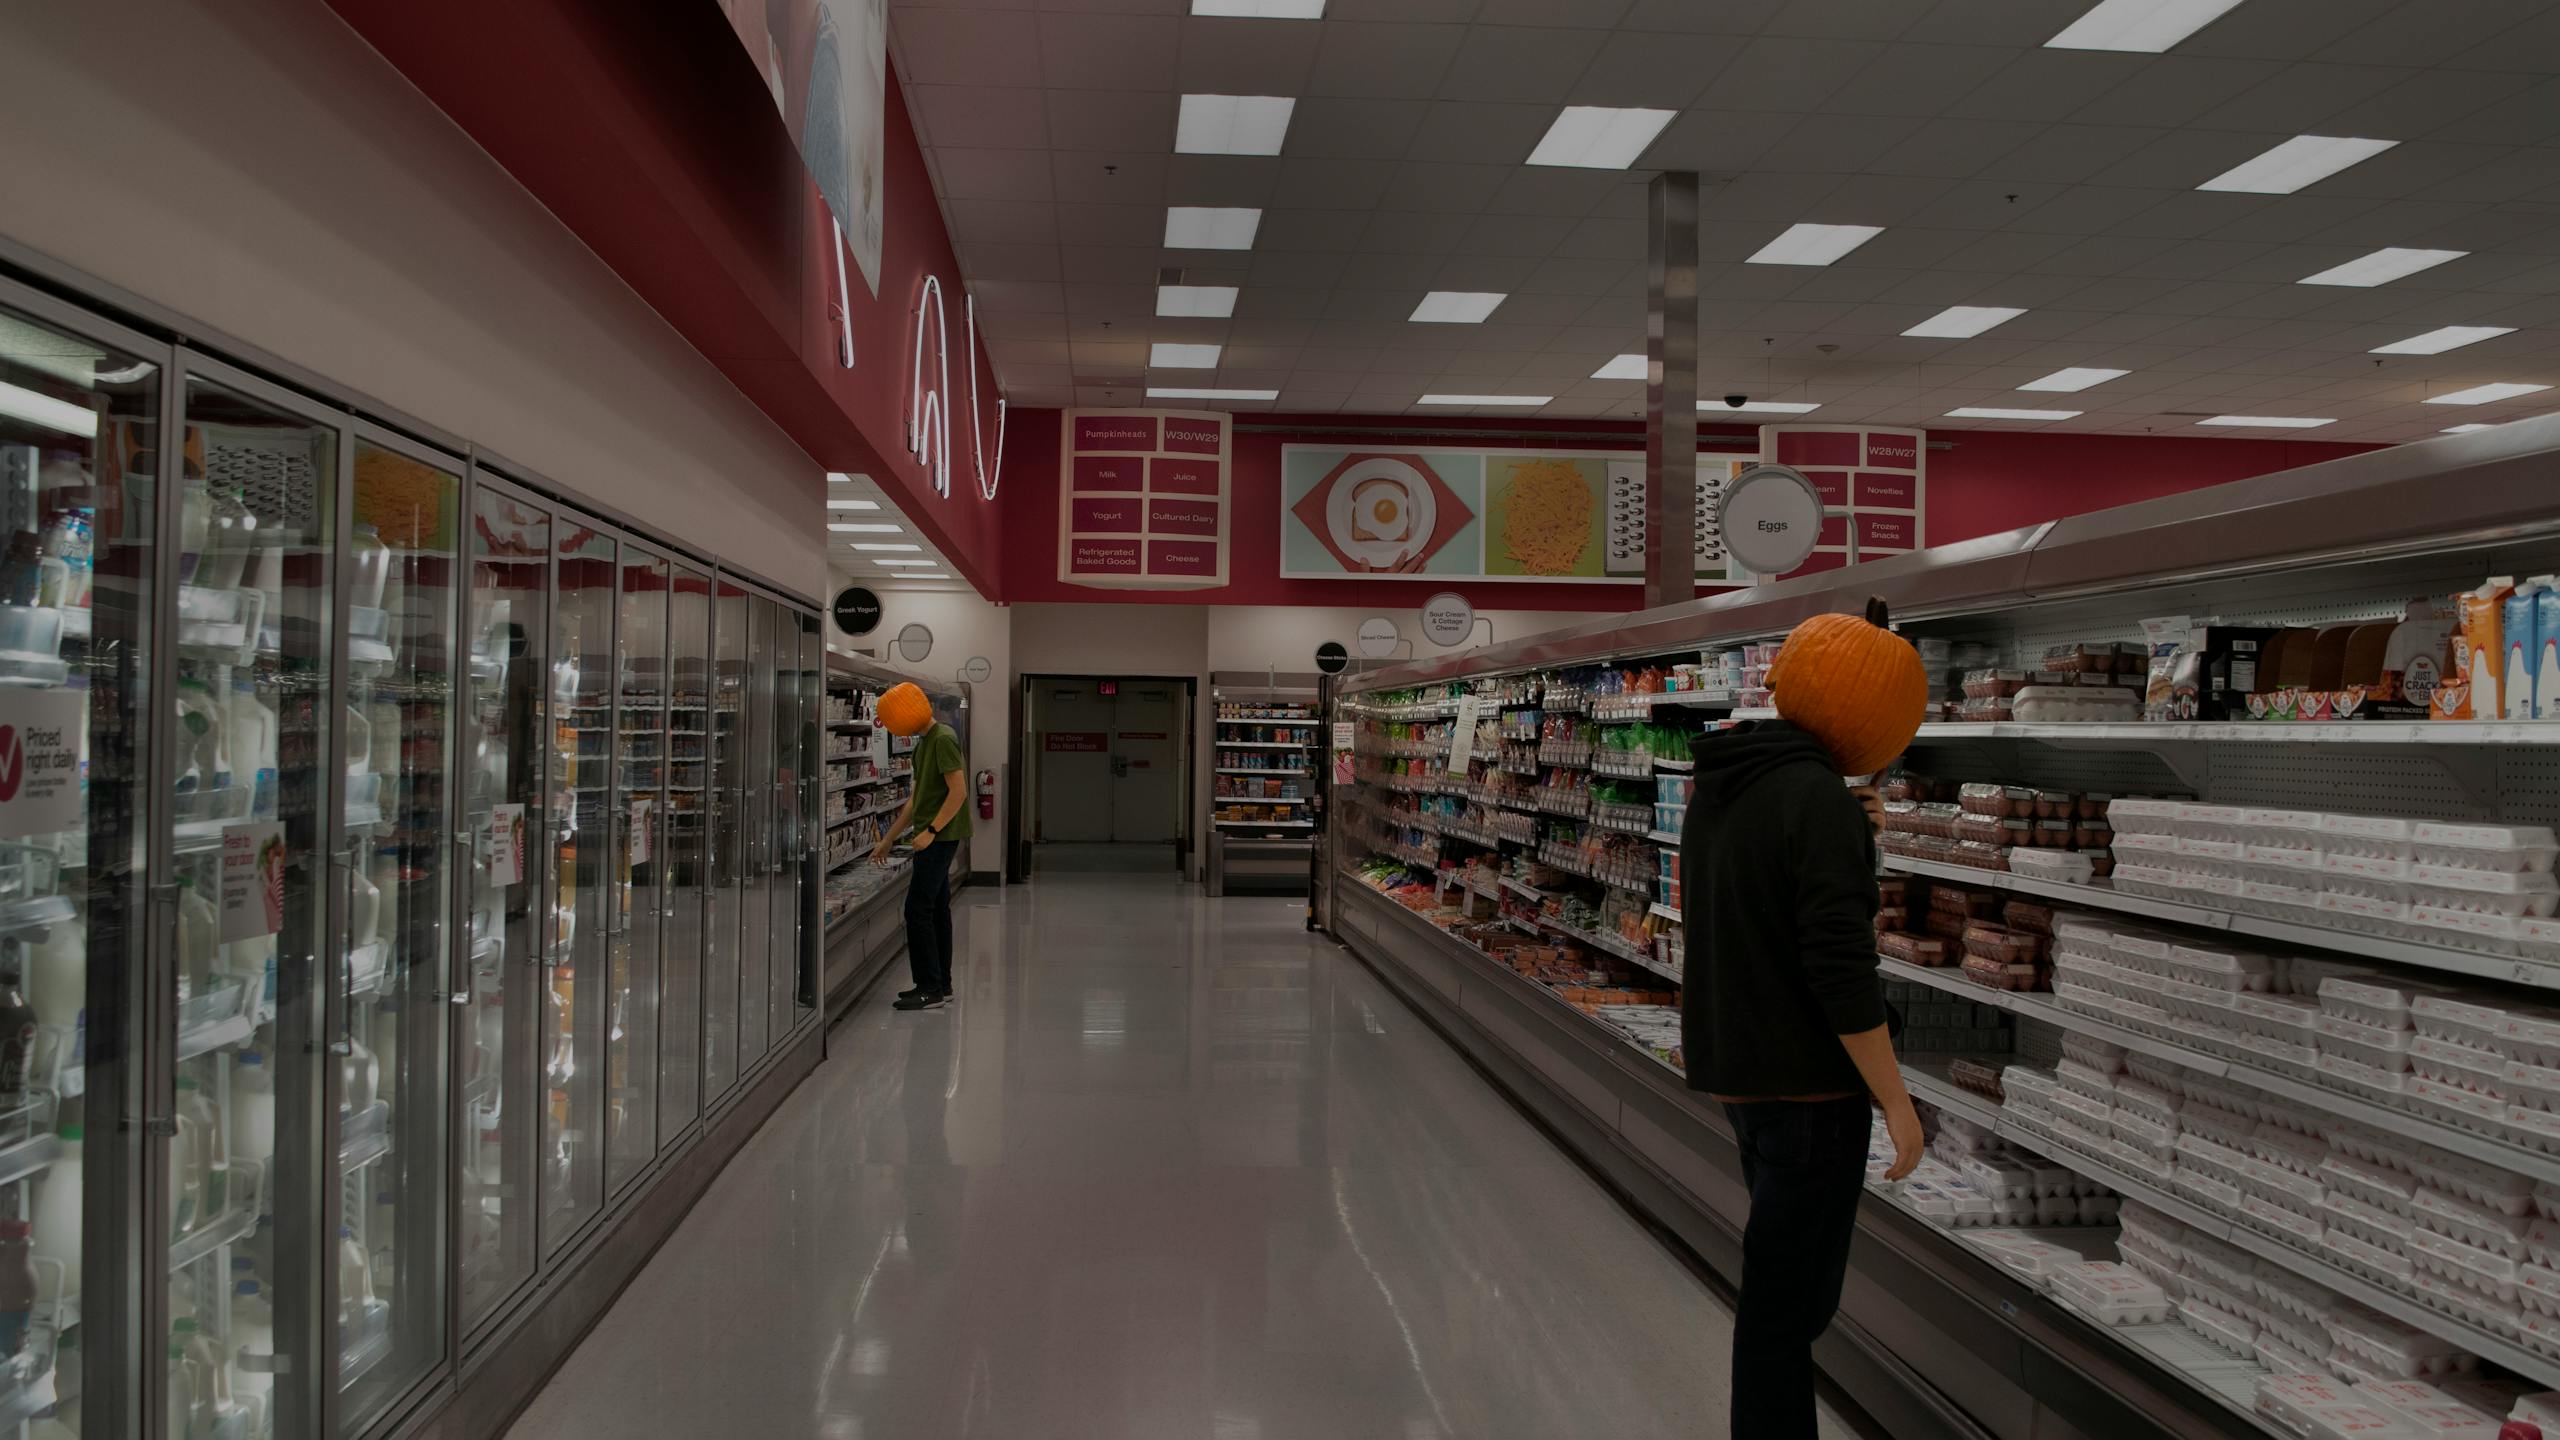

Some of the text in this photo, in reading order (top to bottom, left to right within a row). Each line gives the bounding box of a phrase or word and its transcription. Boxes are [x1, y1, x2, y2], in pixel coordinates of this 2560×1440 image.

[1086, 430, 1147, 439] Pumpkinheads
[1165, 430, 1219, 443] W30/W29
[1868, 446, 1916, 458] W28/W27
[1099, 471, 1117, 479] Milk
[1173, 473, 1197, 481] Juice
[1867, 486, 1904, 496] Novelties
[1093, 511, 1122, 520] Yogurt
[1152, 512, 1214, 524] Cultured Dairy
[1758, 520, 1788, 531] Eggs
[1872, 522, 1899, 531] Frozen
[1871, 531, 1899, 540] Snacks
[1078, 548, 1135, 558] Refrigerated
[1076, 557, 1137, 566] Baked Goods
[1166, 555, 1200, 563] Cheese
[837, 606, 879, 615] Greek Yogurt
[1438, 618, 1463, 626] Cottage
[2413, 671, 2431, 681] JUST
[1100, 681, 1116, 694] EXIT
[2405, 681, 2439, 690] CRACK
[26, 727, 61, 747] Priced
[26, 748, 77, 775] right daily
